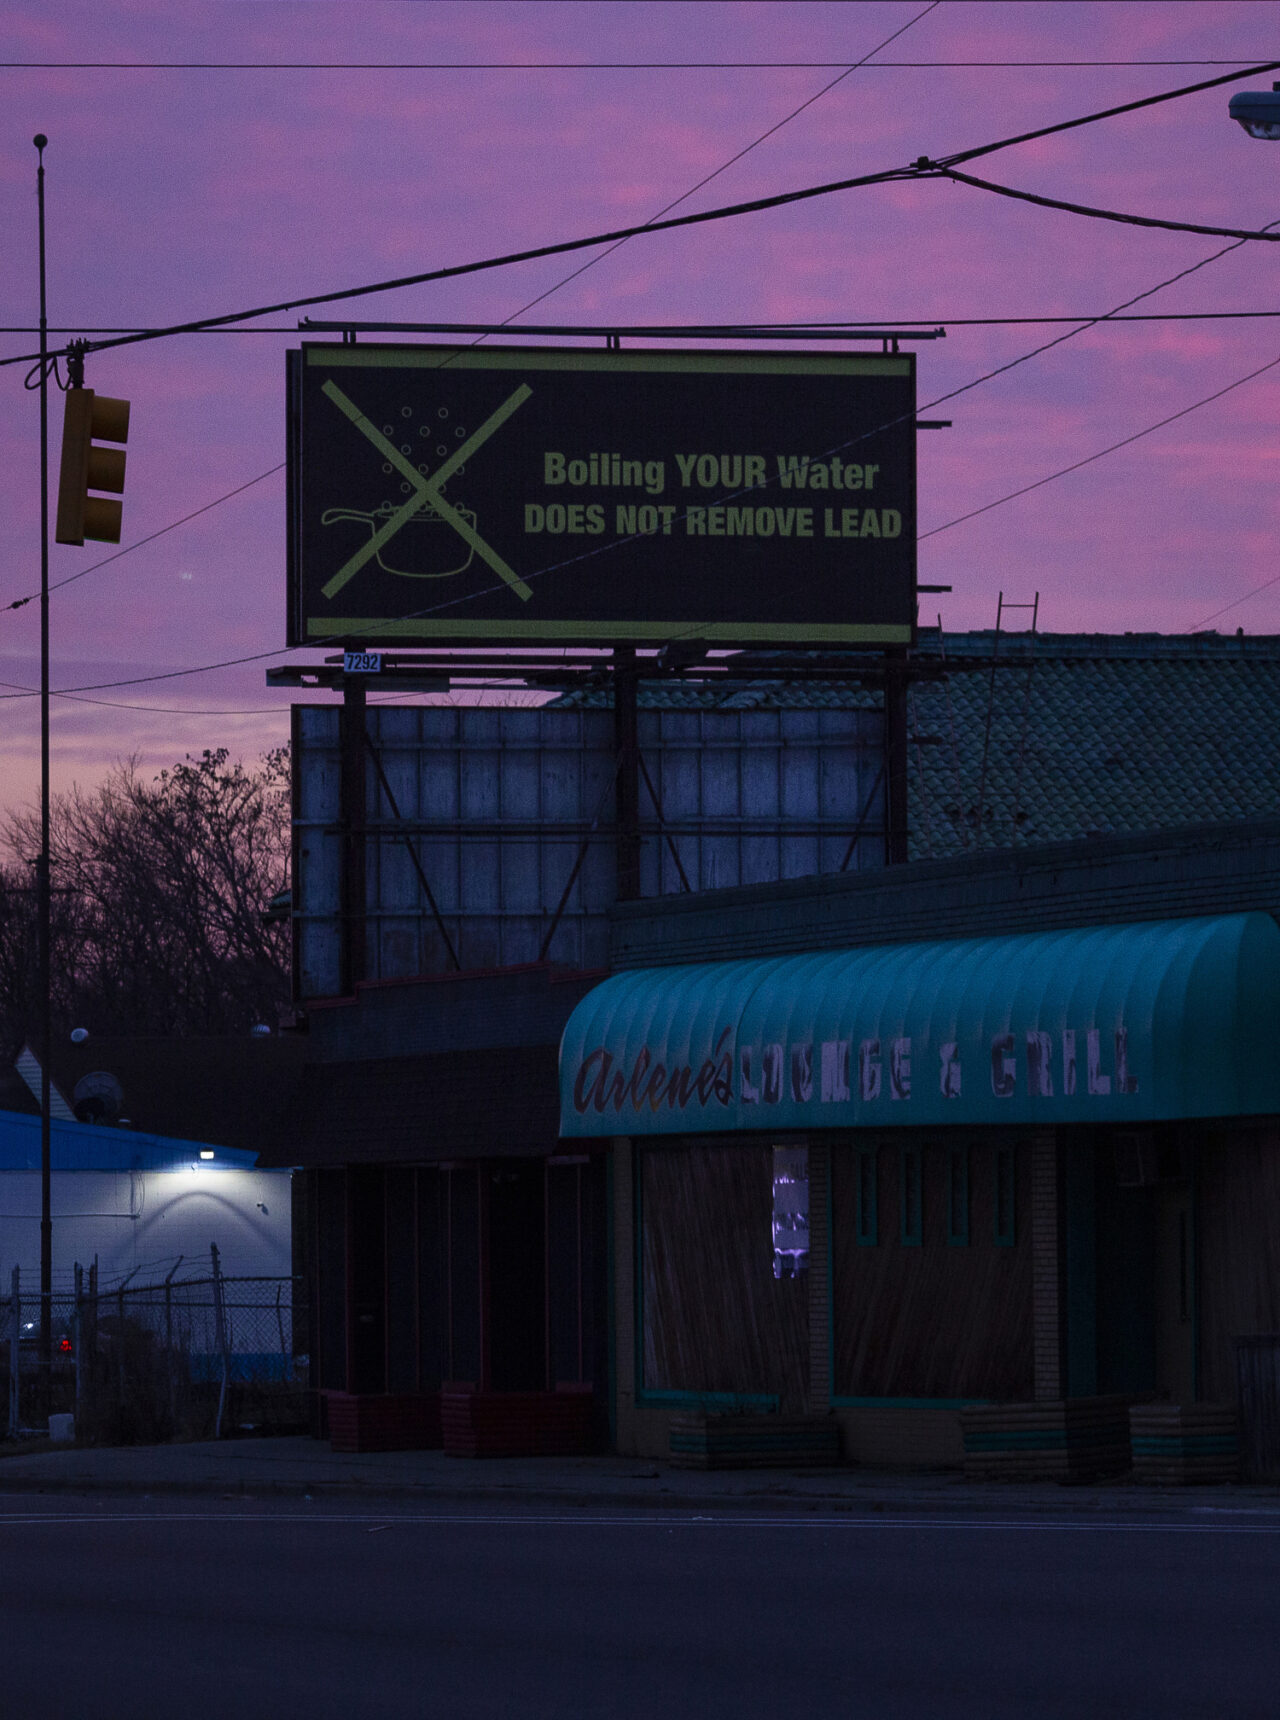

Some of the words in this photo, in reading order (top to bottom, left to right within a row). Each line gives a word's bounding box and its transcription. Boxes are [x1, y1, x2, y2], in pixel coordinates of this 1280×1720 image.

[544, 452, 665, 494] Boiling
[674, 453, 767, 489] YOUR
[776, 455, 880, 490] Water
[524, 504, 606, 534] DOES
[616, 505, 677, 535] NOT
[686, 506, 814, 536] REMOVE
[824, 507, 902, 538] LEAD
[347, 654, 378, 670] 7292
[574, 1024, 734, 1113] Arlene's
[939, 1041, 962, 1098] &
[991, 1027, 1139, 1098] GRILL
